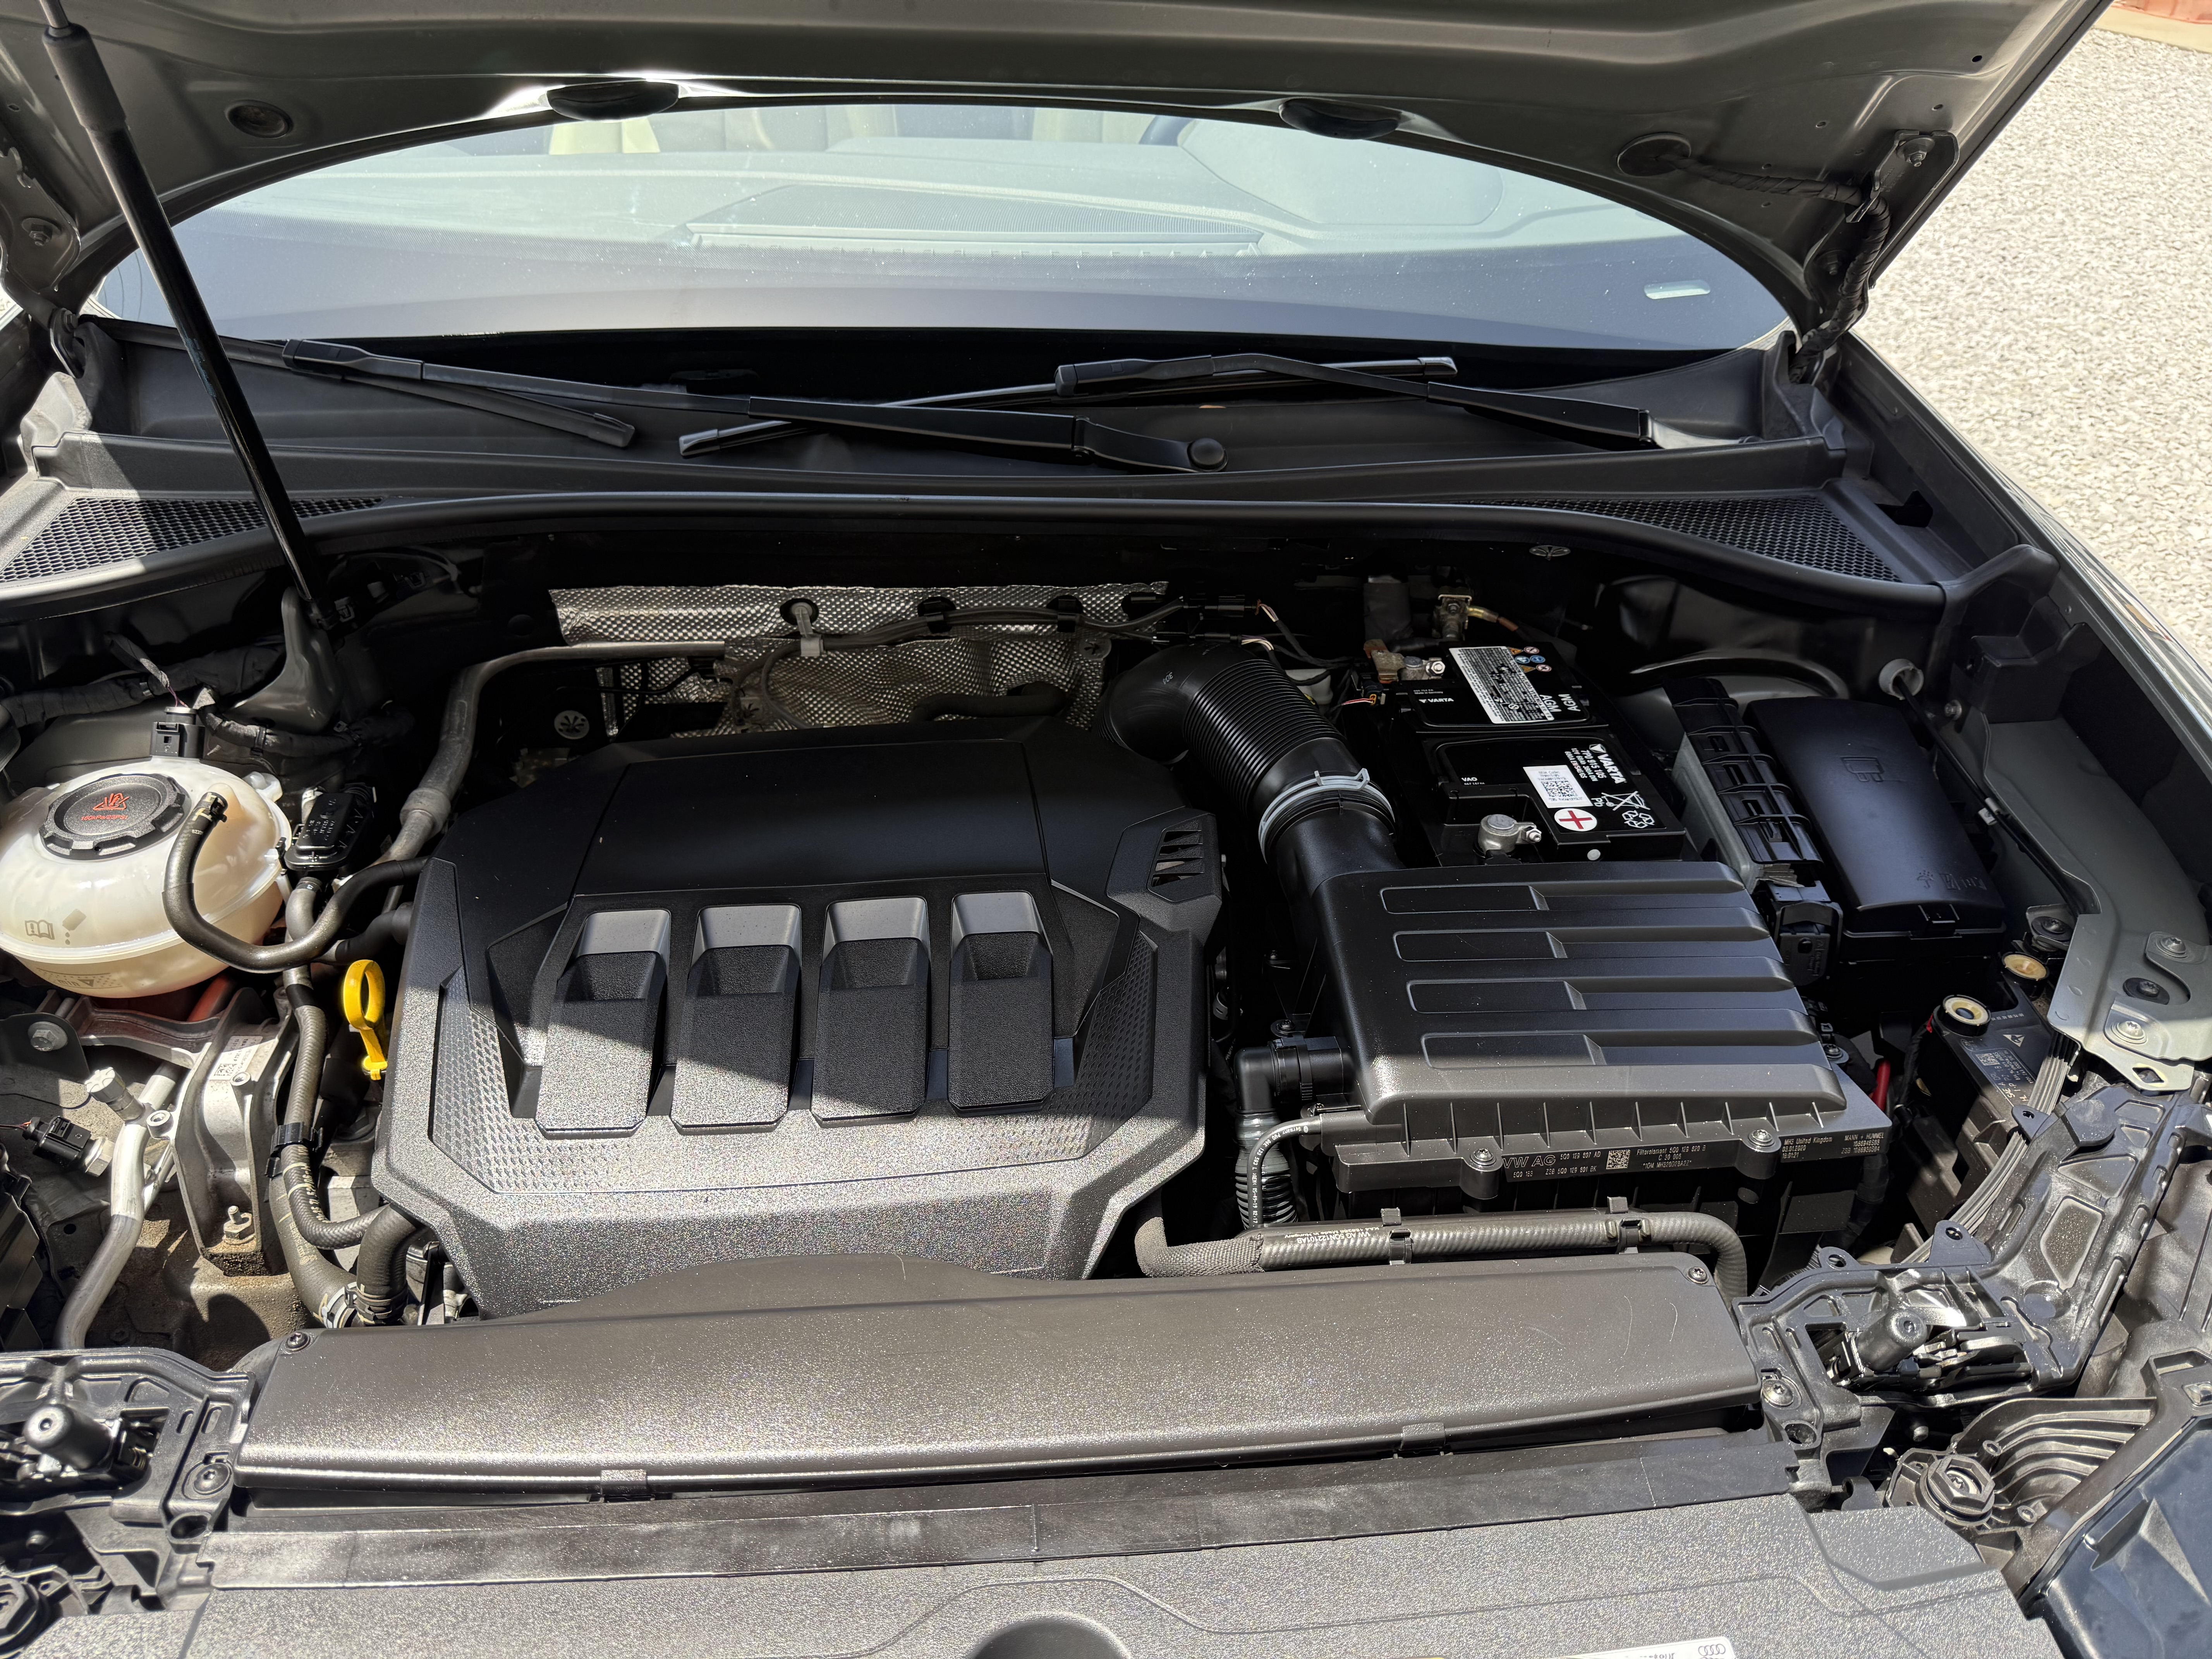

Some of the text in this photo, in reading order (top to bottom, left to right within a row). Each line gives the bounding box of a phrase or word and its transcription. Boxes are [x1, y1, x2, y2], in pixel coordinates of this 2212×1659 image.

[1539, 694, 1562, 712] AGM
[1558, 694, 1581, 712] AGM
[1587, 759, 1600, 769] 915
[1594, 769, 1607, 778] 105
[1597, 753, 1626, 784] VARTA
[1591, 798, 1604, 807] Pb
[1502, 1155, 1556, 1168] VW AG
